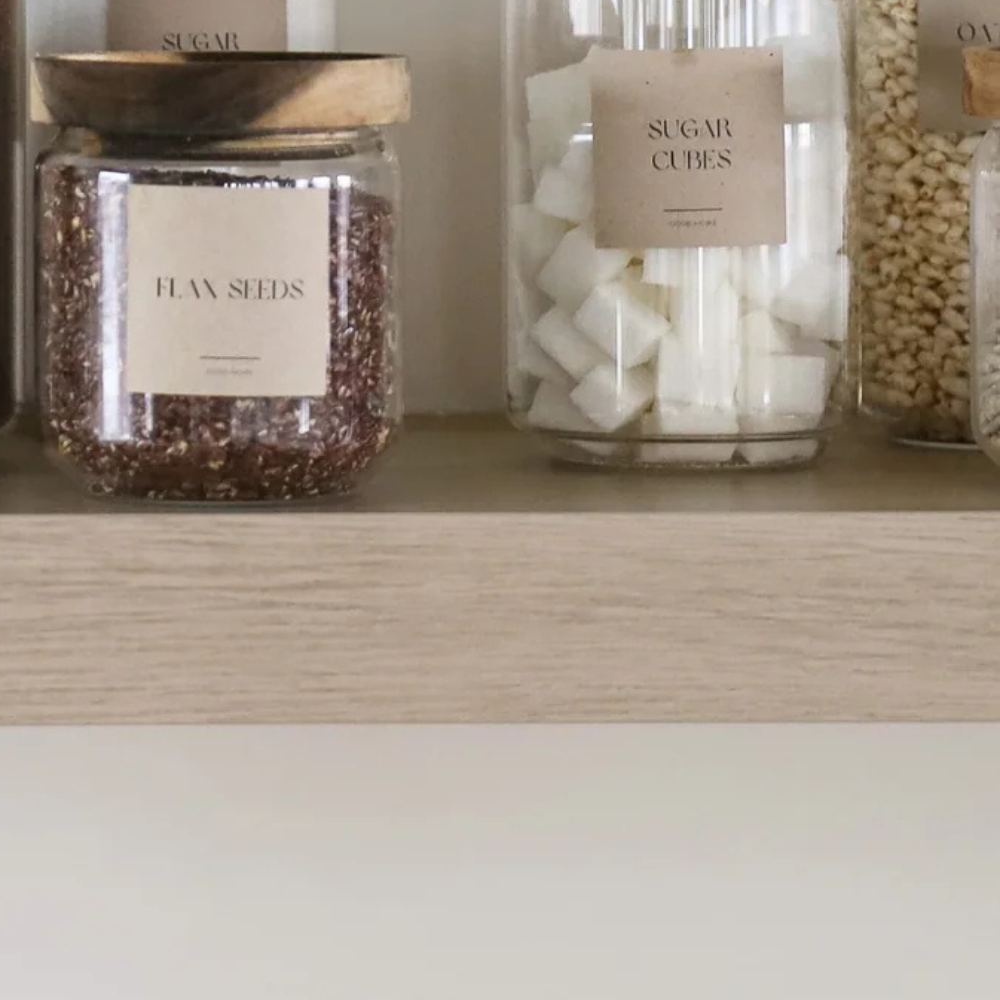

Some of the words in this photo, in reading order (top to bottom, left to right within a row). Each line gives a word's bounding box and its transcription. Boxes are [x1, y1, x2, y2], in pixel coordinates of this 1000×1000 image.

[161, 32, 240, 51] SUGAR
[957, 21, 1000, 42] OA
[647, 118, 733, 140] SUGAR
[651, 148, 732, 171] CUBES
[156, 276, 218, 300] FLAX
[228, 277, 305, 300] SEEDS
